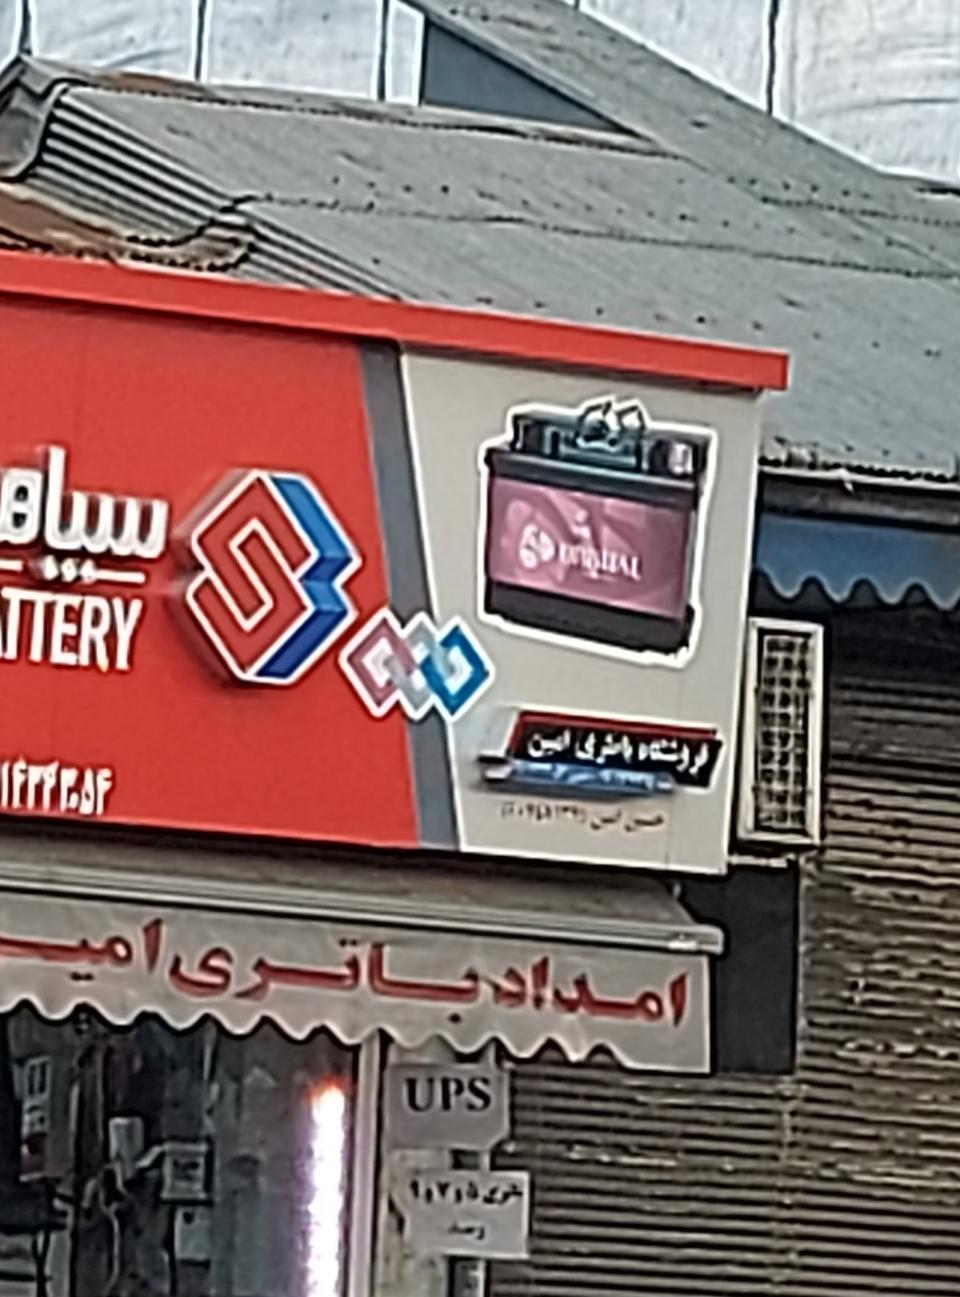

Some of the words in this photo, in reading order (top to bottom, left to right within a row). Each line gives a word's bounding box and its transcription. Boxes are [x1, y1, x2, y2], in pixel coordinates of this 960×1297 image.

[167, 938, 480, 1024] باتری
[488, 955, 688, 1028] امداد
[403, 1075, 493, 1113] UPS
